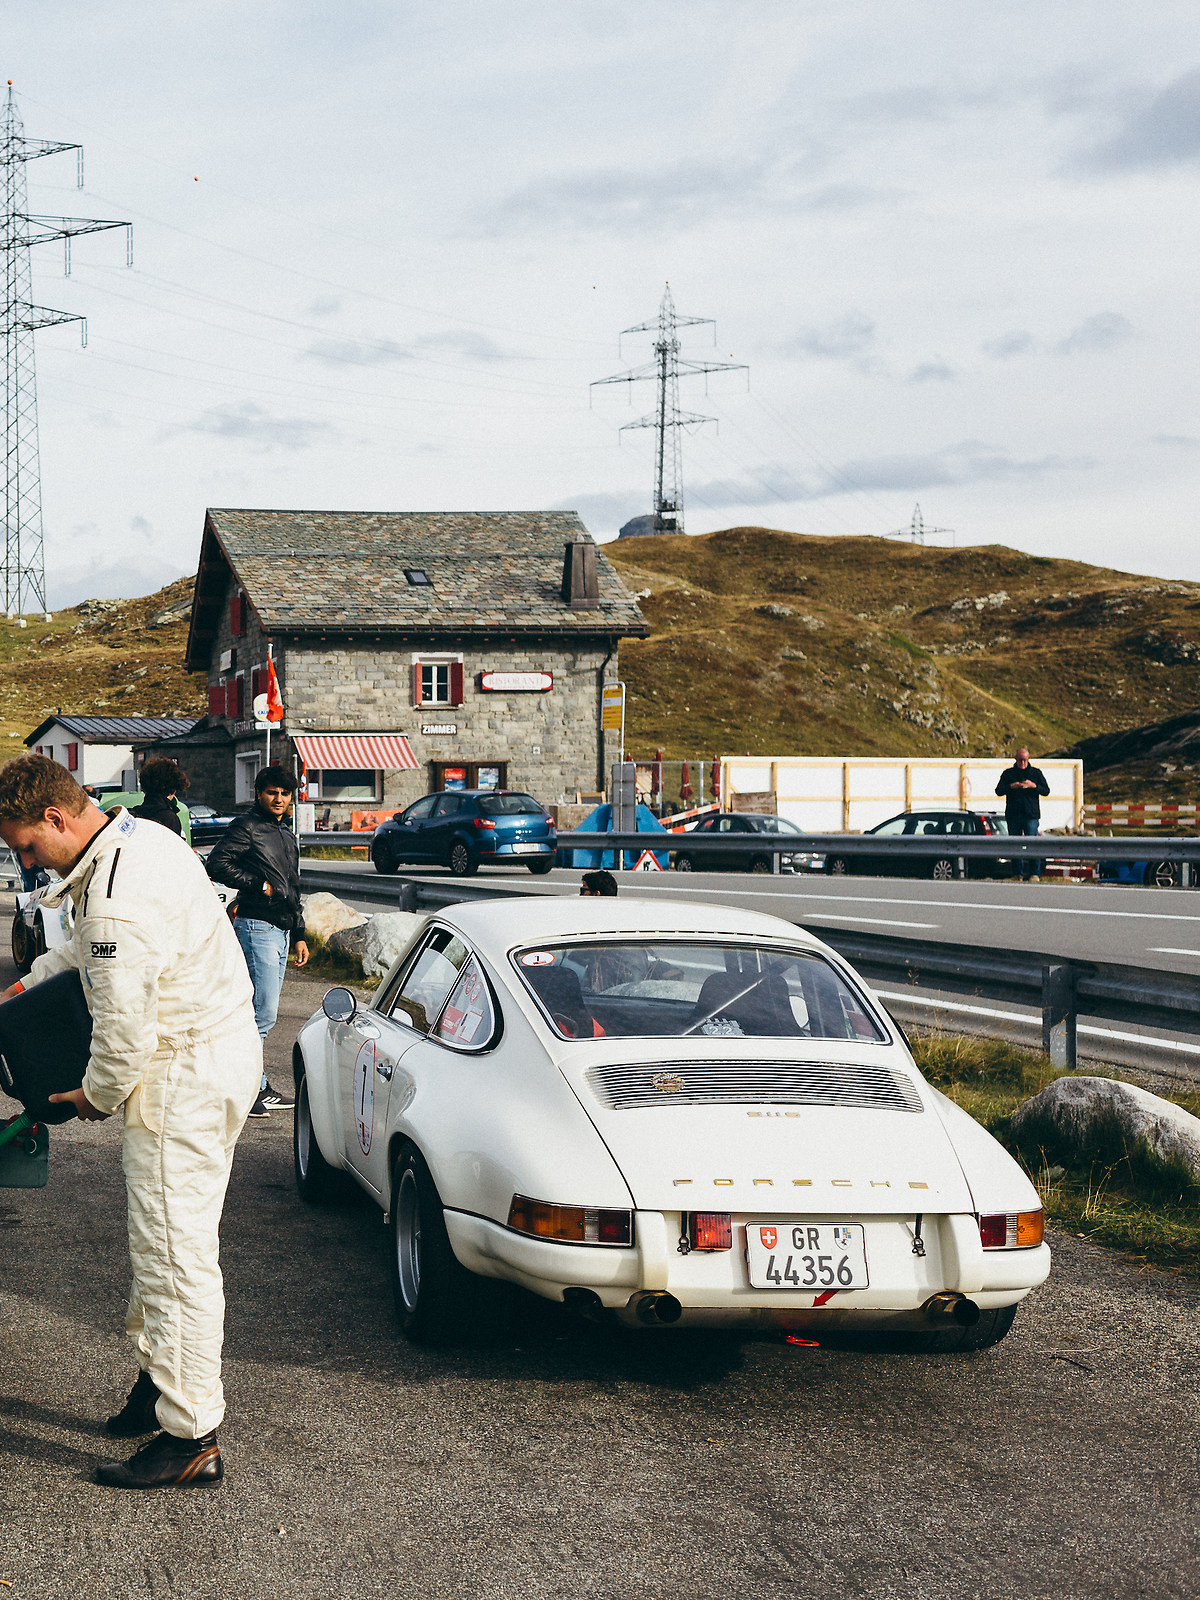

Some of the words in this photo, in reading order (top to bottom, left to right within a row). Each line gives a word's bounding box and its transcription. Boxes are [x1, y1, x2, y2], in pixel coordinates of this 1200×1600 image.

[422, 724, 457, 734] ZIMMER
[91, 945, 117, 955] OMP
[673, 1178, 929, 1190] PORSCHE
[791, 1227, 821, 1250] GR
[766, 1255, 853, 1286] 44356
